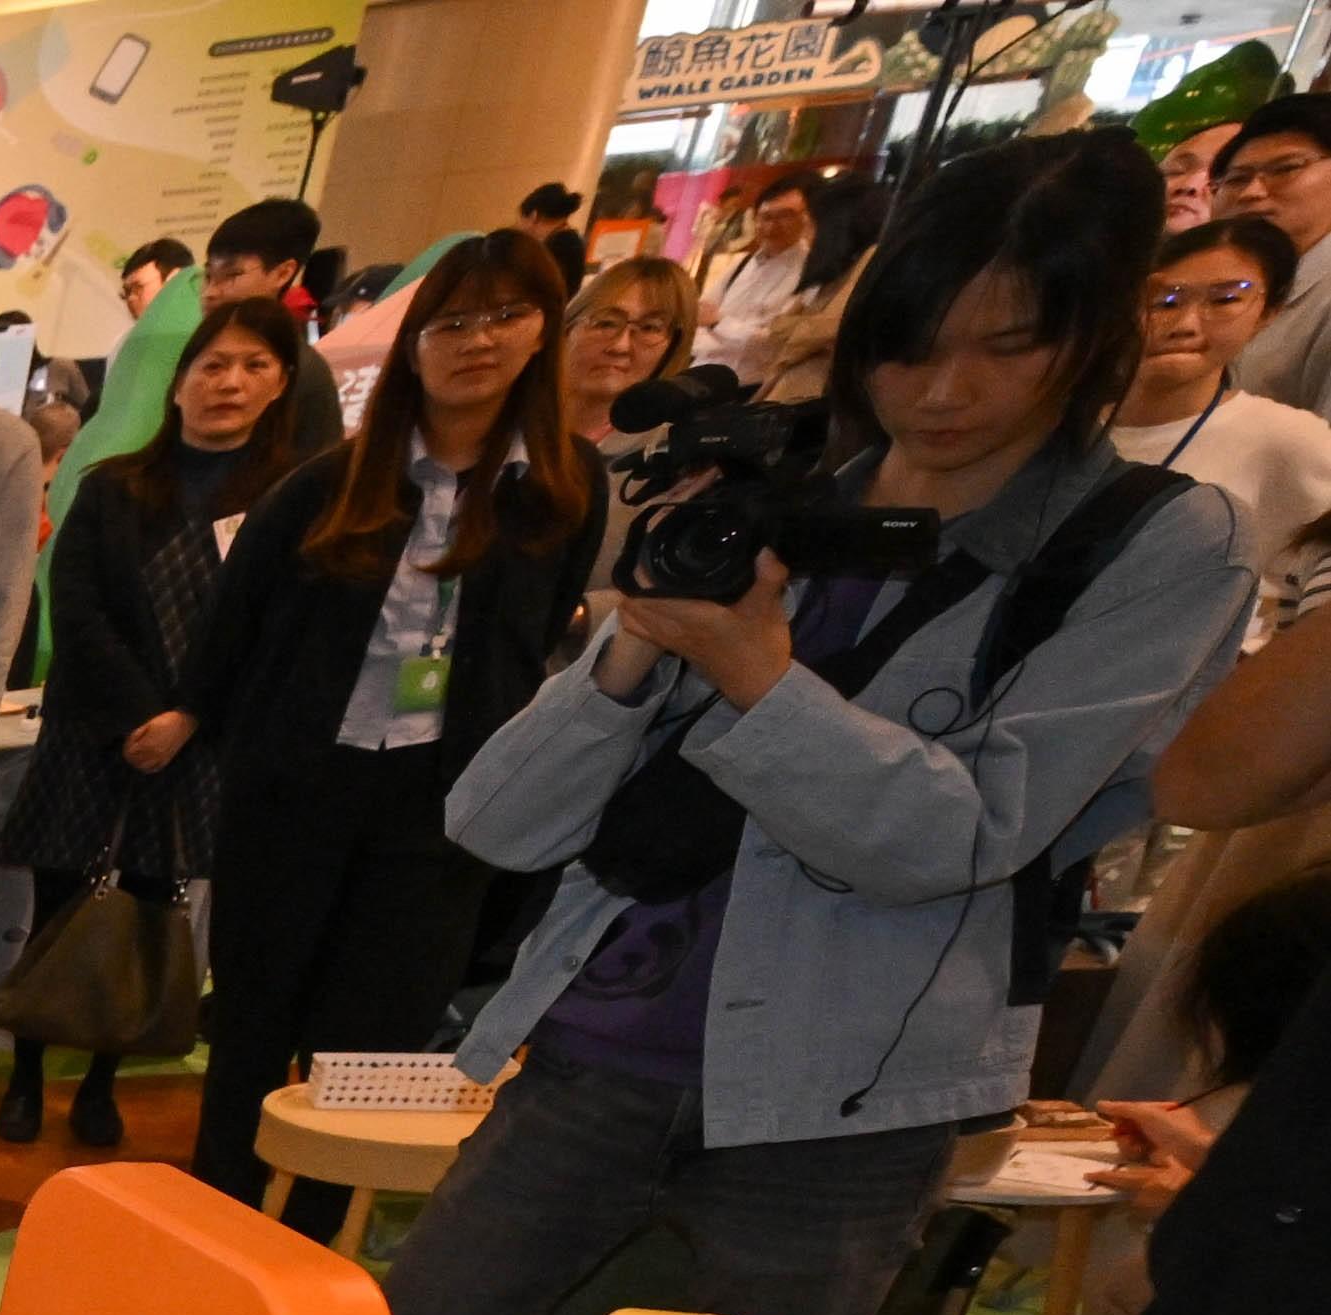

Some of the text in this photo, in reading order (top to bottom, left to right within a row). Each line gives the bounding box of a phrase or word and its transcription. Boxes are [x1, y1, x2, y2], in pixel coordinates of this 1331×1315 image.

[640, 25, 826, 78] 鯨魚花園
[639, 67, 814, 99] WHALE GARDEN
[882, 520, 918, 528] SONY
